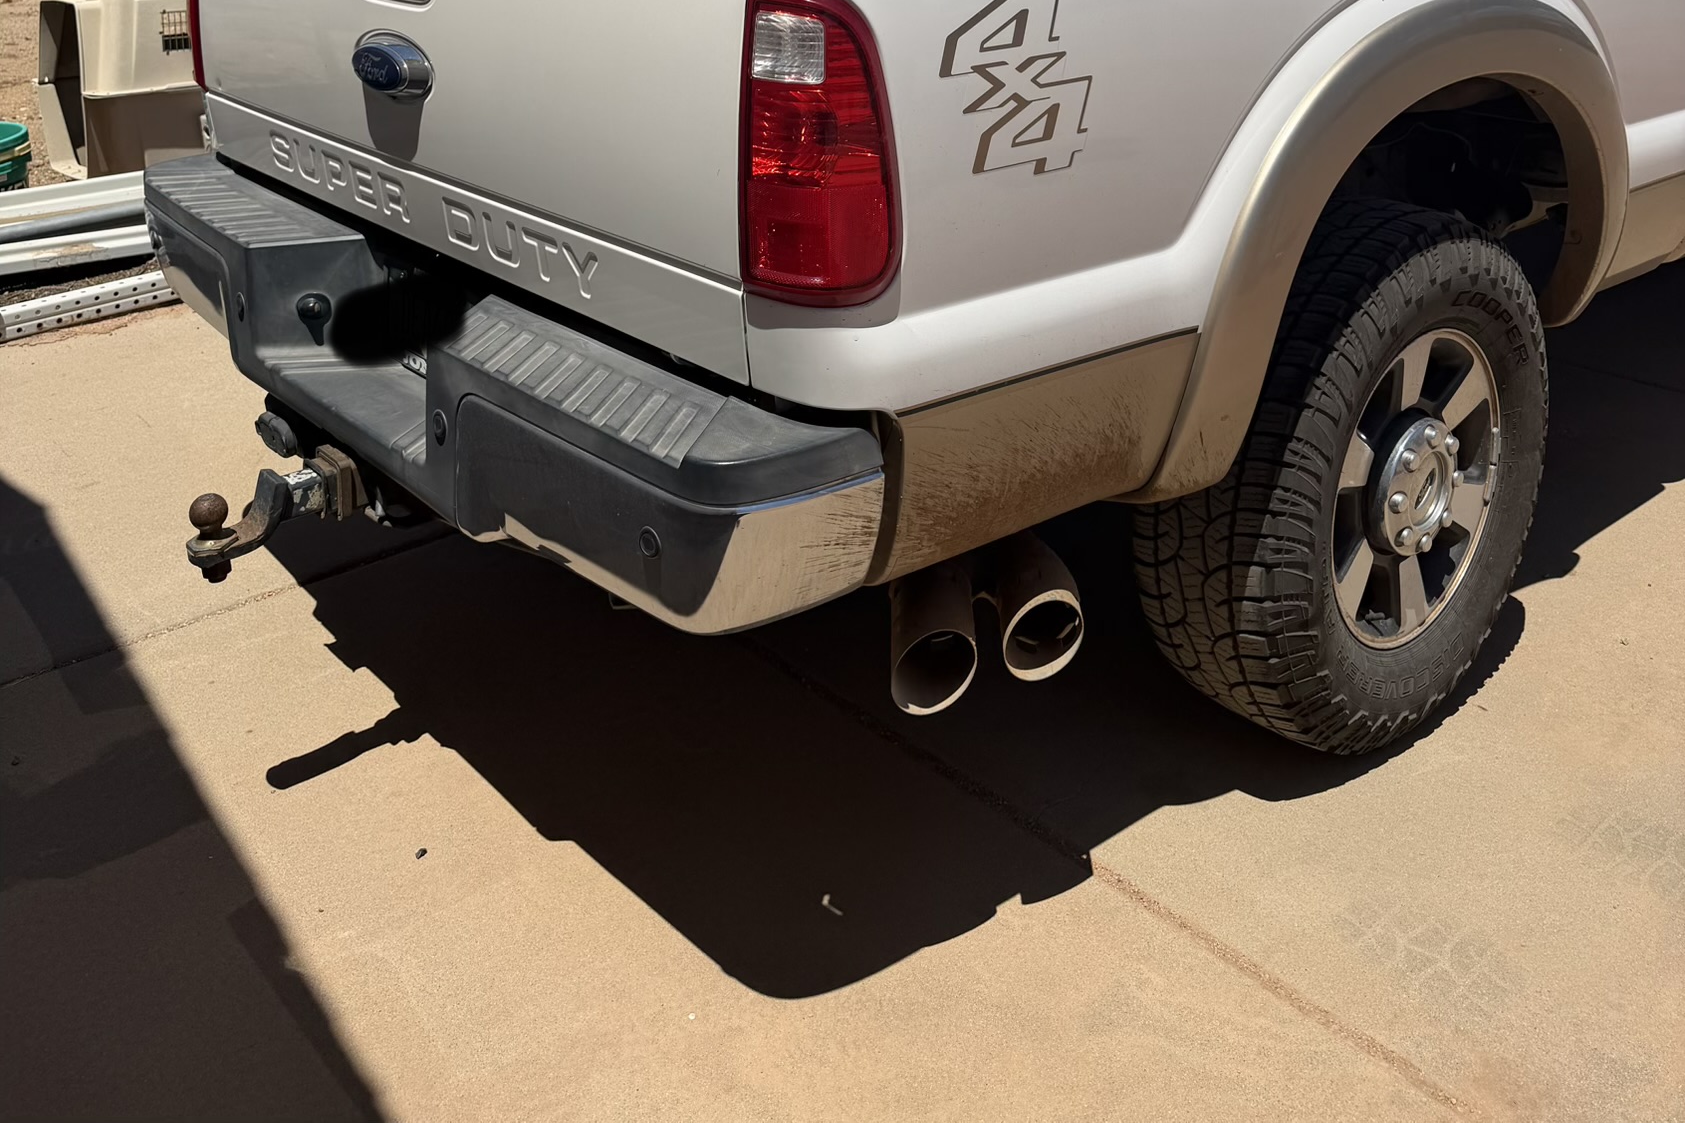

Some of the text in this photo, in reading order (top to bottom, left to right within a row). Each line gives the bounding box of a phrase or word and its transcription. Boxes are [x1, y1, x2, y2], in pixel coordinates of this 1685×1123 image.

[358, 52, 389, 84] Ford
[269, 128, 599, 300] SUPER DUTY
[1451, 289, 1530, 366] COOPER
[1336, 631, 1465, 701] DISCOVERER
